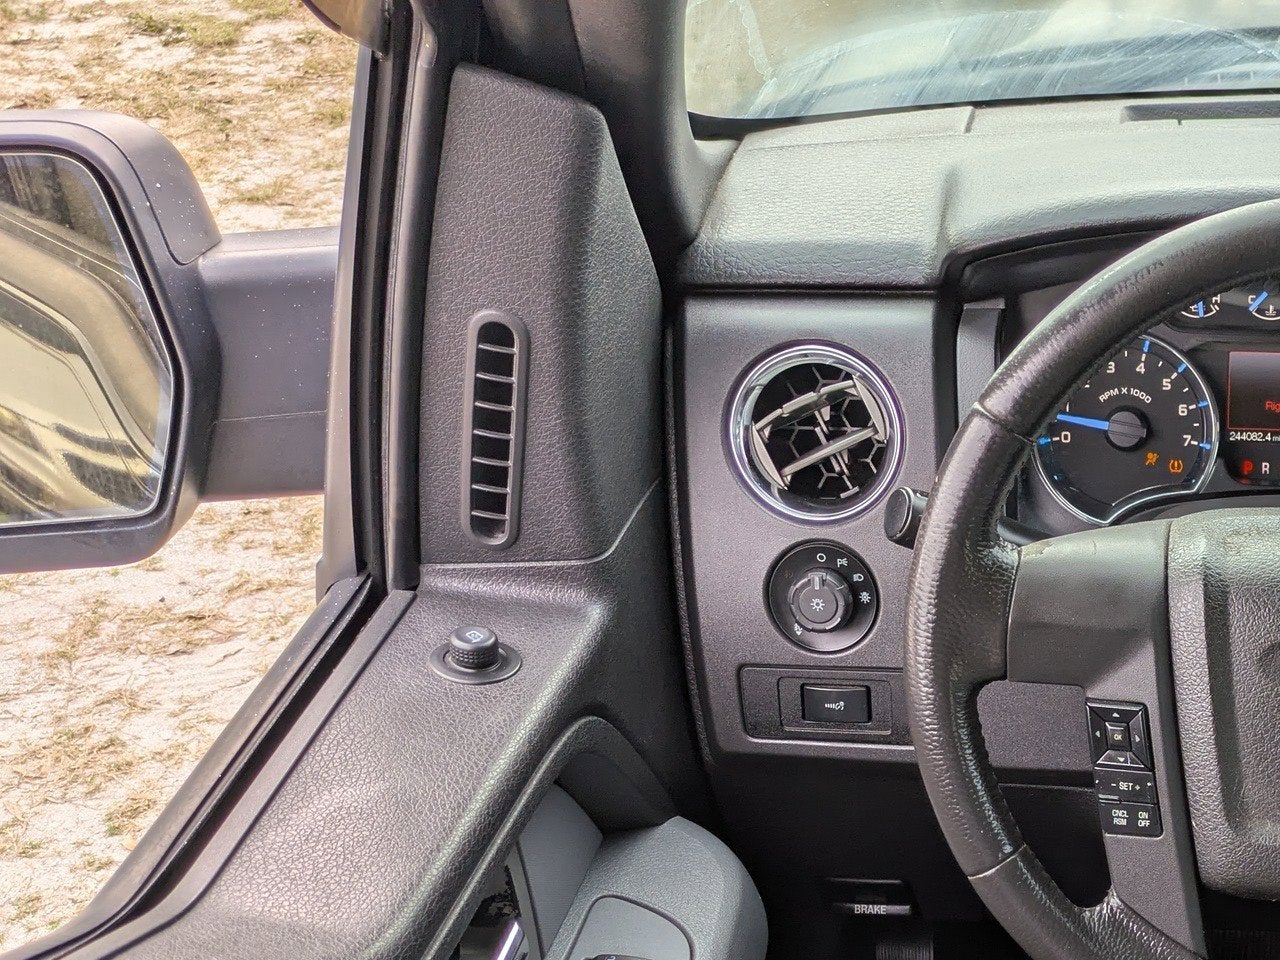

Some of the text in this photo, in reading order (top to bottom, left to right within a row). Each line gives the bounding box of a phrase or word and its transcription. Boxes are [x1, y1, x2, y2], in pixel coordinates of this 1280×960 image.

[1106, 362, 1115, 374] 3
[1136, 363, 1146, 374] 4
[1162, 379, 1171, 390] 5
[1099, 388, 1119, 404] RPM
[1130, 388, 1152, 404] 1000
[1178, 404, 1188, 416] 6
[1061, 431, 1071, 443] 0
[1183, 435, 1191, 447] 7
[1229, 432, 1272, 442] 244082.4
[1243, 461, 1253, 475] P
[1262, 463, 1270, 474] R
[1119, 782, 1133, 790] SET
[1112, 809, 1129, 818] CNCL
[1138, 811, 1148, 819] ON
[1113, 818, 1127, 826] RSM
[1138, 819, 1150, 827] OFF
[854, 904, 887, 914] BRAKE
